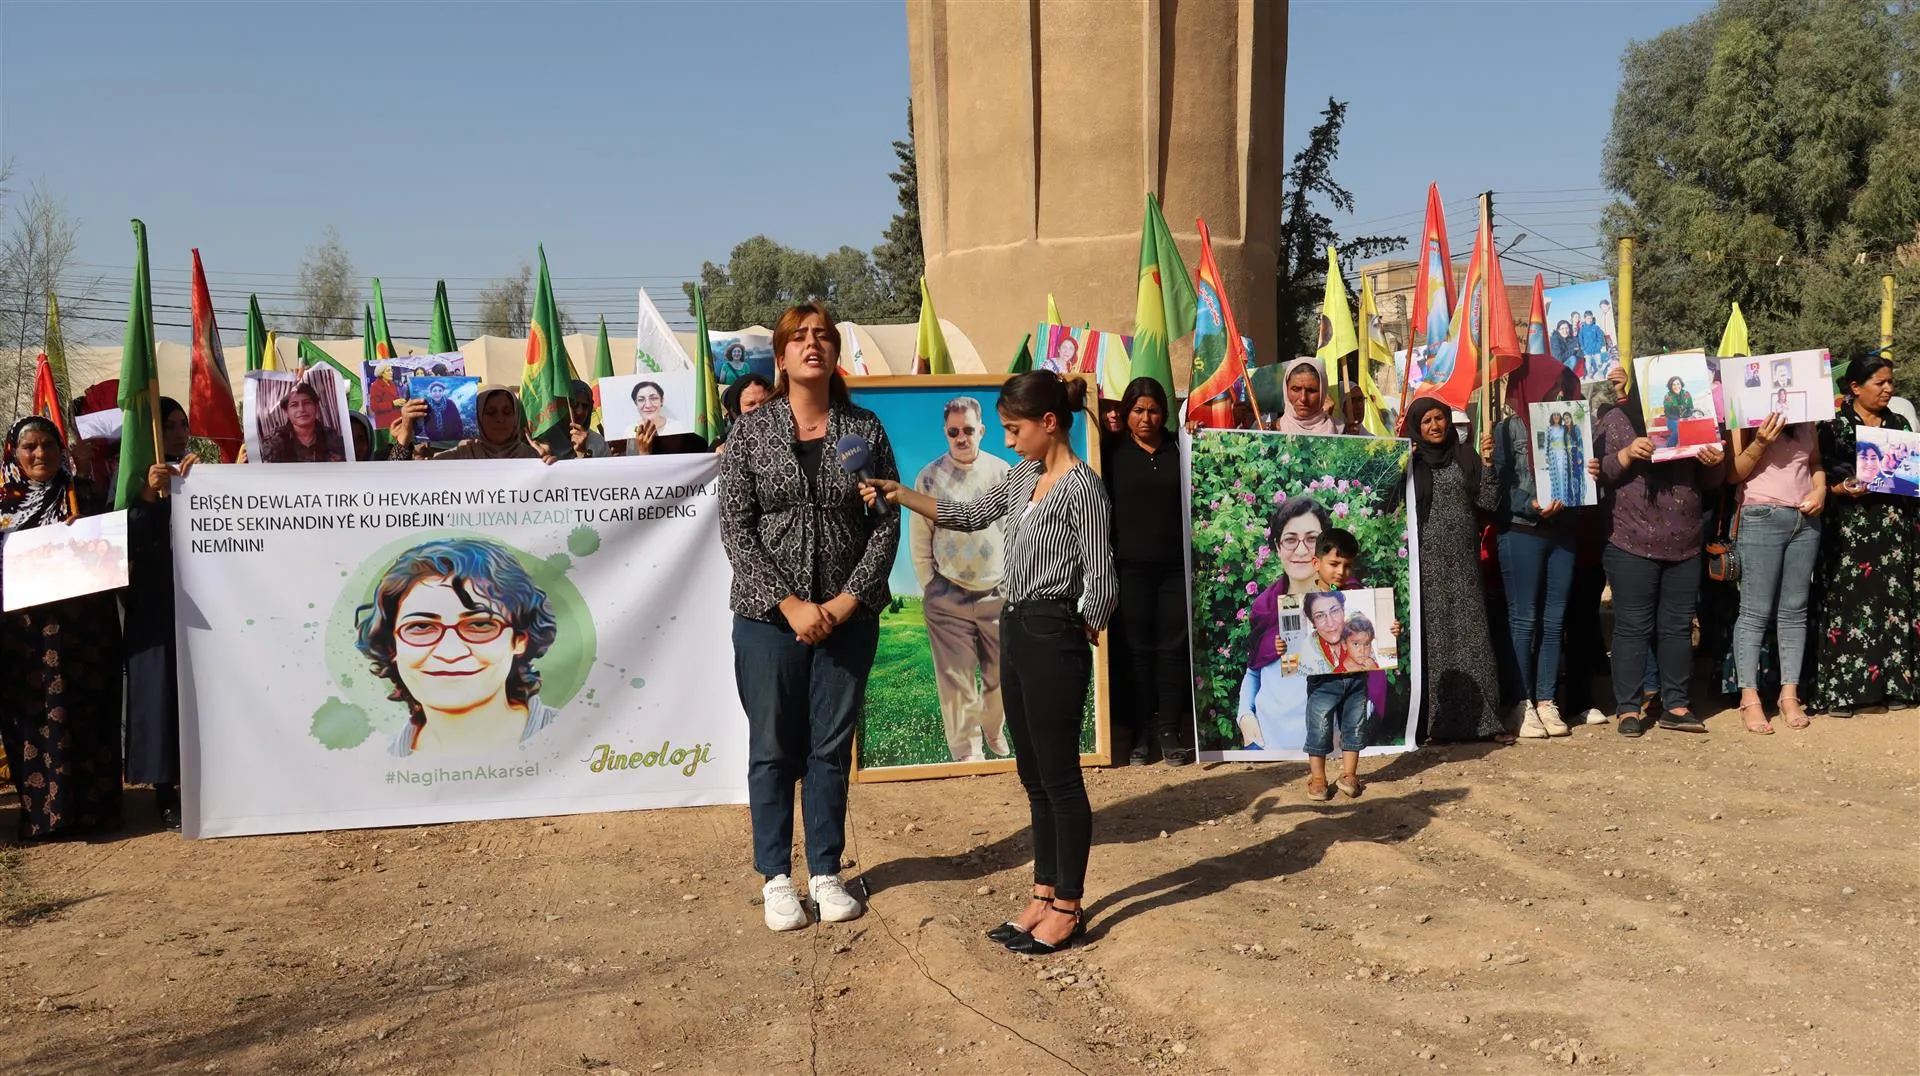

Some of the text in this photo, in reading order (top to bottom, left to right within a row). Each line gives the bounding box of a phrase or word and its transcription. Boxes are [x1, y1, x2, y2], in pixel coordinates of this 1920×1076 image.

[190, 494, 243, 513] ÊRÎŞÊN
[247, 494, 321, 510] DEWLATA
[325, 493, 358, 508] TIRK
[363, 491, 374, 507] Û
[378, 490, 461, 507] HEVKARÊN
[465, 488, 484, 505] WÎ
[487, 488, 506, 505] YÊ
[509, 489, 529, 504] TU
[533, 487, 569, 503] CARÎ
[572, 486, 639, 502] TEVGERA
[644, 483, 707, 500] AZADIYA
[191, 517, 234, 532] NEDE
[237, 515, 333, 531] SEKINANDIN
[336, 513, 356, 529] YÊ
[360, 513, 381, 528] KU
[385, 512, 444, 528] DIBÊJIN
[574, 508, 595, 523] TU
[599, 506, 634, 522] CARÎ
[637, 503, 697, 521] BÊDENG
[191, 536, 264, 554] NEMÎNIN!
[384, 761, 541, 787] #NagihanAkarsel
